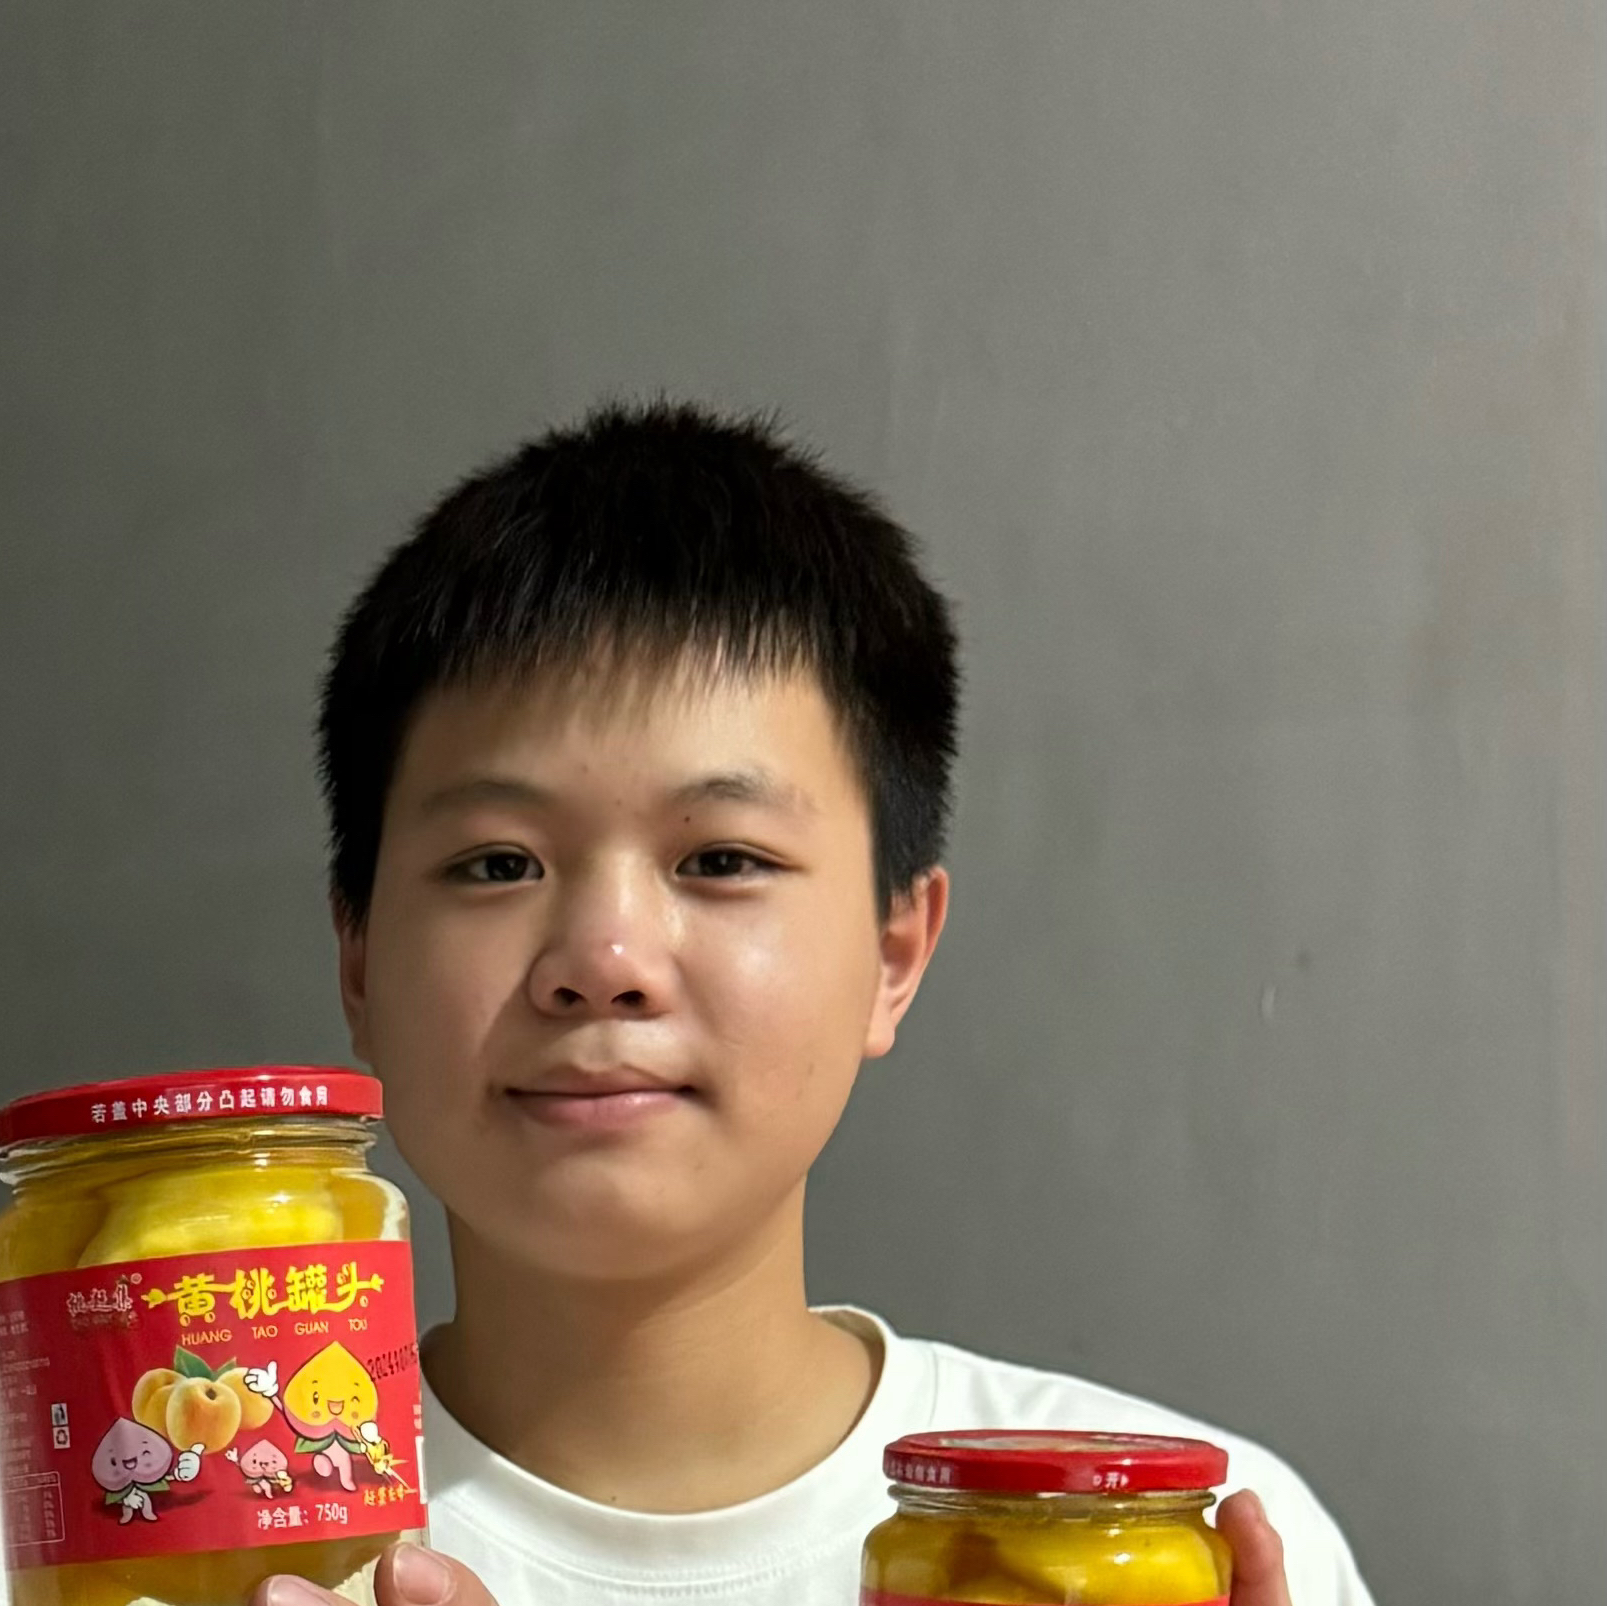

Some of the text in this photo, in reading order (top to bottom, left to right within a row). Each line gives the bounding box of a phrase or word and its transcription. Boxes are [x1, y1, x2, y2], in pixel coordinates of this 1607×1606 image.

[174, 1261, 374, 1327] 黄桃罐头
[181, 1317, 368, 1346] HUANG TAO GUAN TOU
[315, 1502, 349, 1525] 750g
